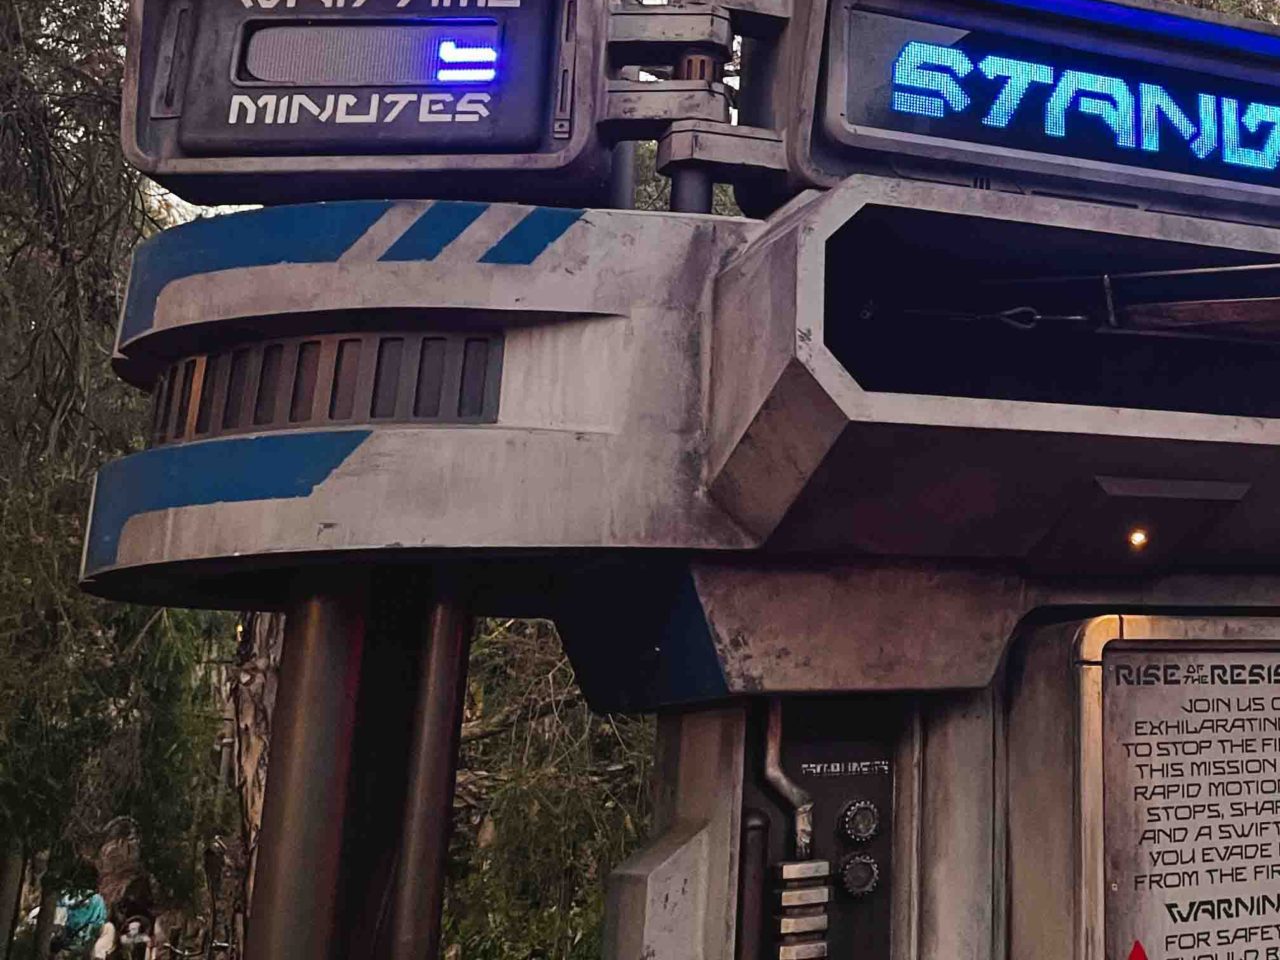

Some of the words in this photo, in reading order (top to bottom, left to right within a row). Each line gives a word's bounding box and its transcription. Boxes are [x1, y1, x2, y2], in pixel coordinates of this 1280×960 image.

[228, 93, 490, 124] MINUTES
[1115, 664, 1181, 686] RISE
[1186, 664, 1205, 674] OF
[1183, 675, 1209, 685] THE
[1181, 698, 1231, 713] JOIN
[1236, 697, 1265, 712] US
[1123, 742, 1152, 758] TO
[1156, 740, 1212, 756] STOP
[1217, 738, 1257, 754] THE
[1135, 763, 1185, 779] THIS
[1190, 759, 1277, 777] MISSION
[1134, 783, 1201, 801] RAPID
[1147, 803, 1225, 822] STOPS,
[1139, 827, 1188, 845] AND
[1195, 825, 1212, 842] A
[1150, 849, 1196, 867] YOU
[1201, 843, 1272, 863] EVADE
[1134, 872, 1200, 890] FROM
[1206, 866, 1248, 885] THE
[1165, 931, 1211, 951] FOR
